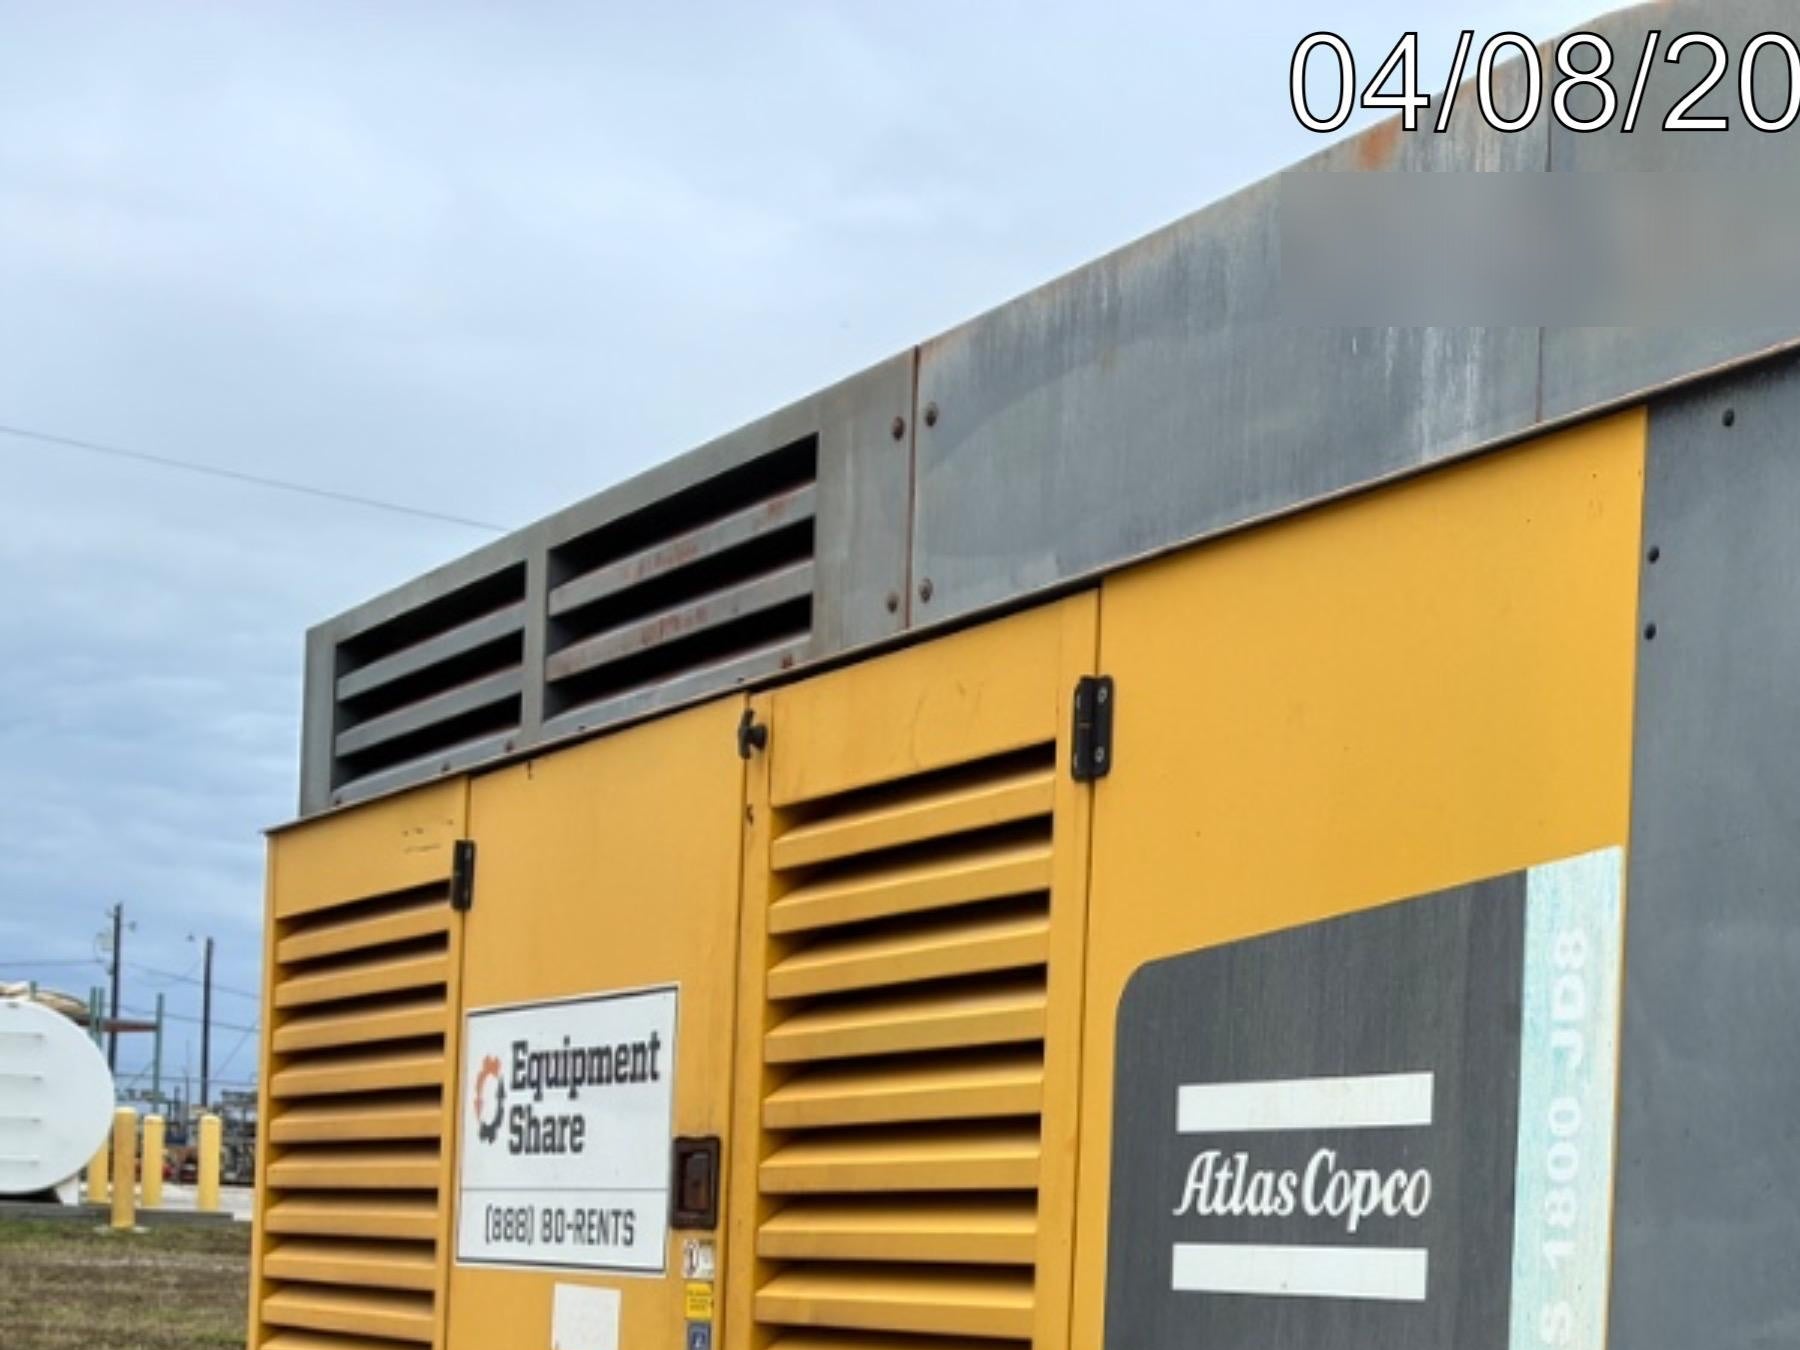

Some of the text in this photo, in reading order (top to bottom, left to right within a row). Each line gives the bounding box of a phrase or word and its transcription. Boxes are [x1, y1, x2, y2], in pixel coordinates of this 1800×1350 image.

[1551, 927, 1588, 1069] JD8
[511, 1031, 660, 1101] Equipment
[508, 1104, 584, 1155] Share
[1173, 1148, 1431, 1232] Atlas Copco
[1543, 1101, 1583, 1270] 1800
[485, 1203, 635, 1247] (888) 80-RENTS
